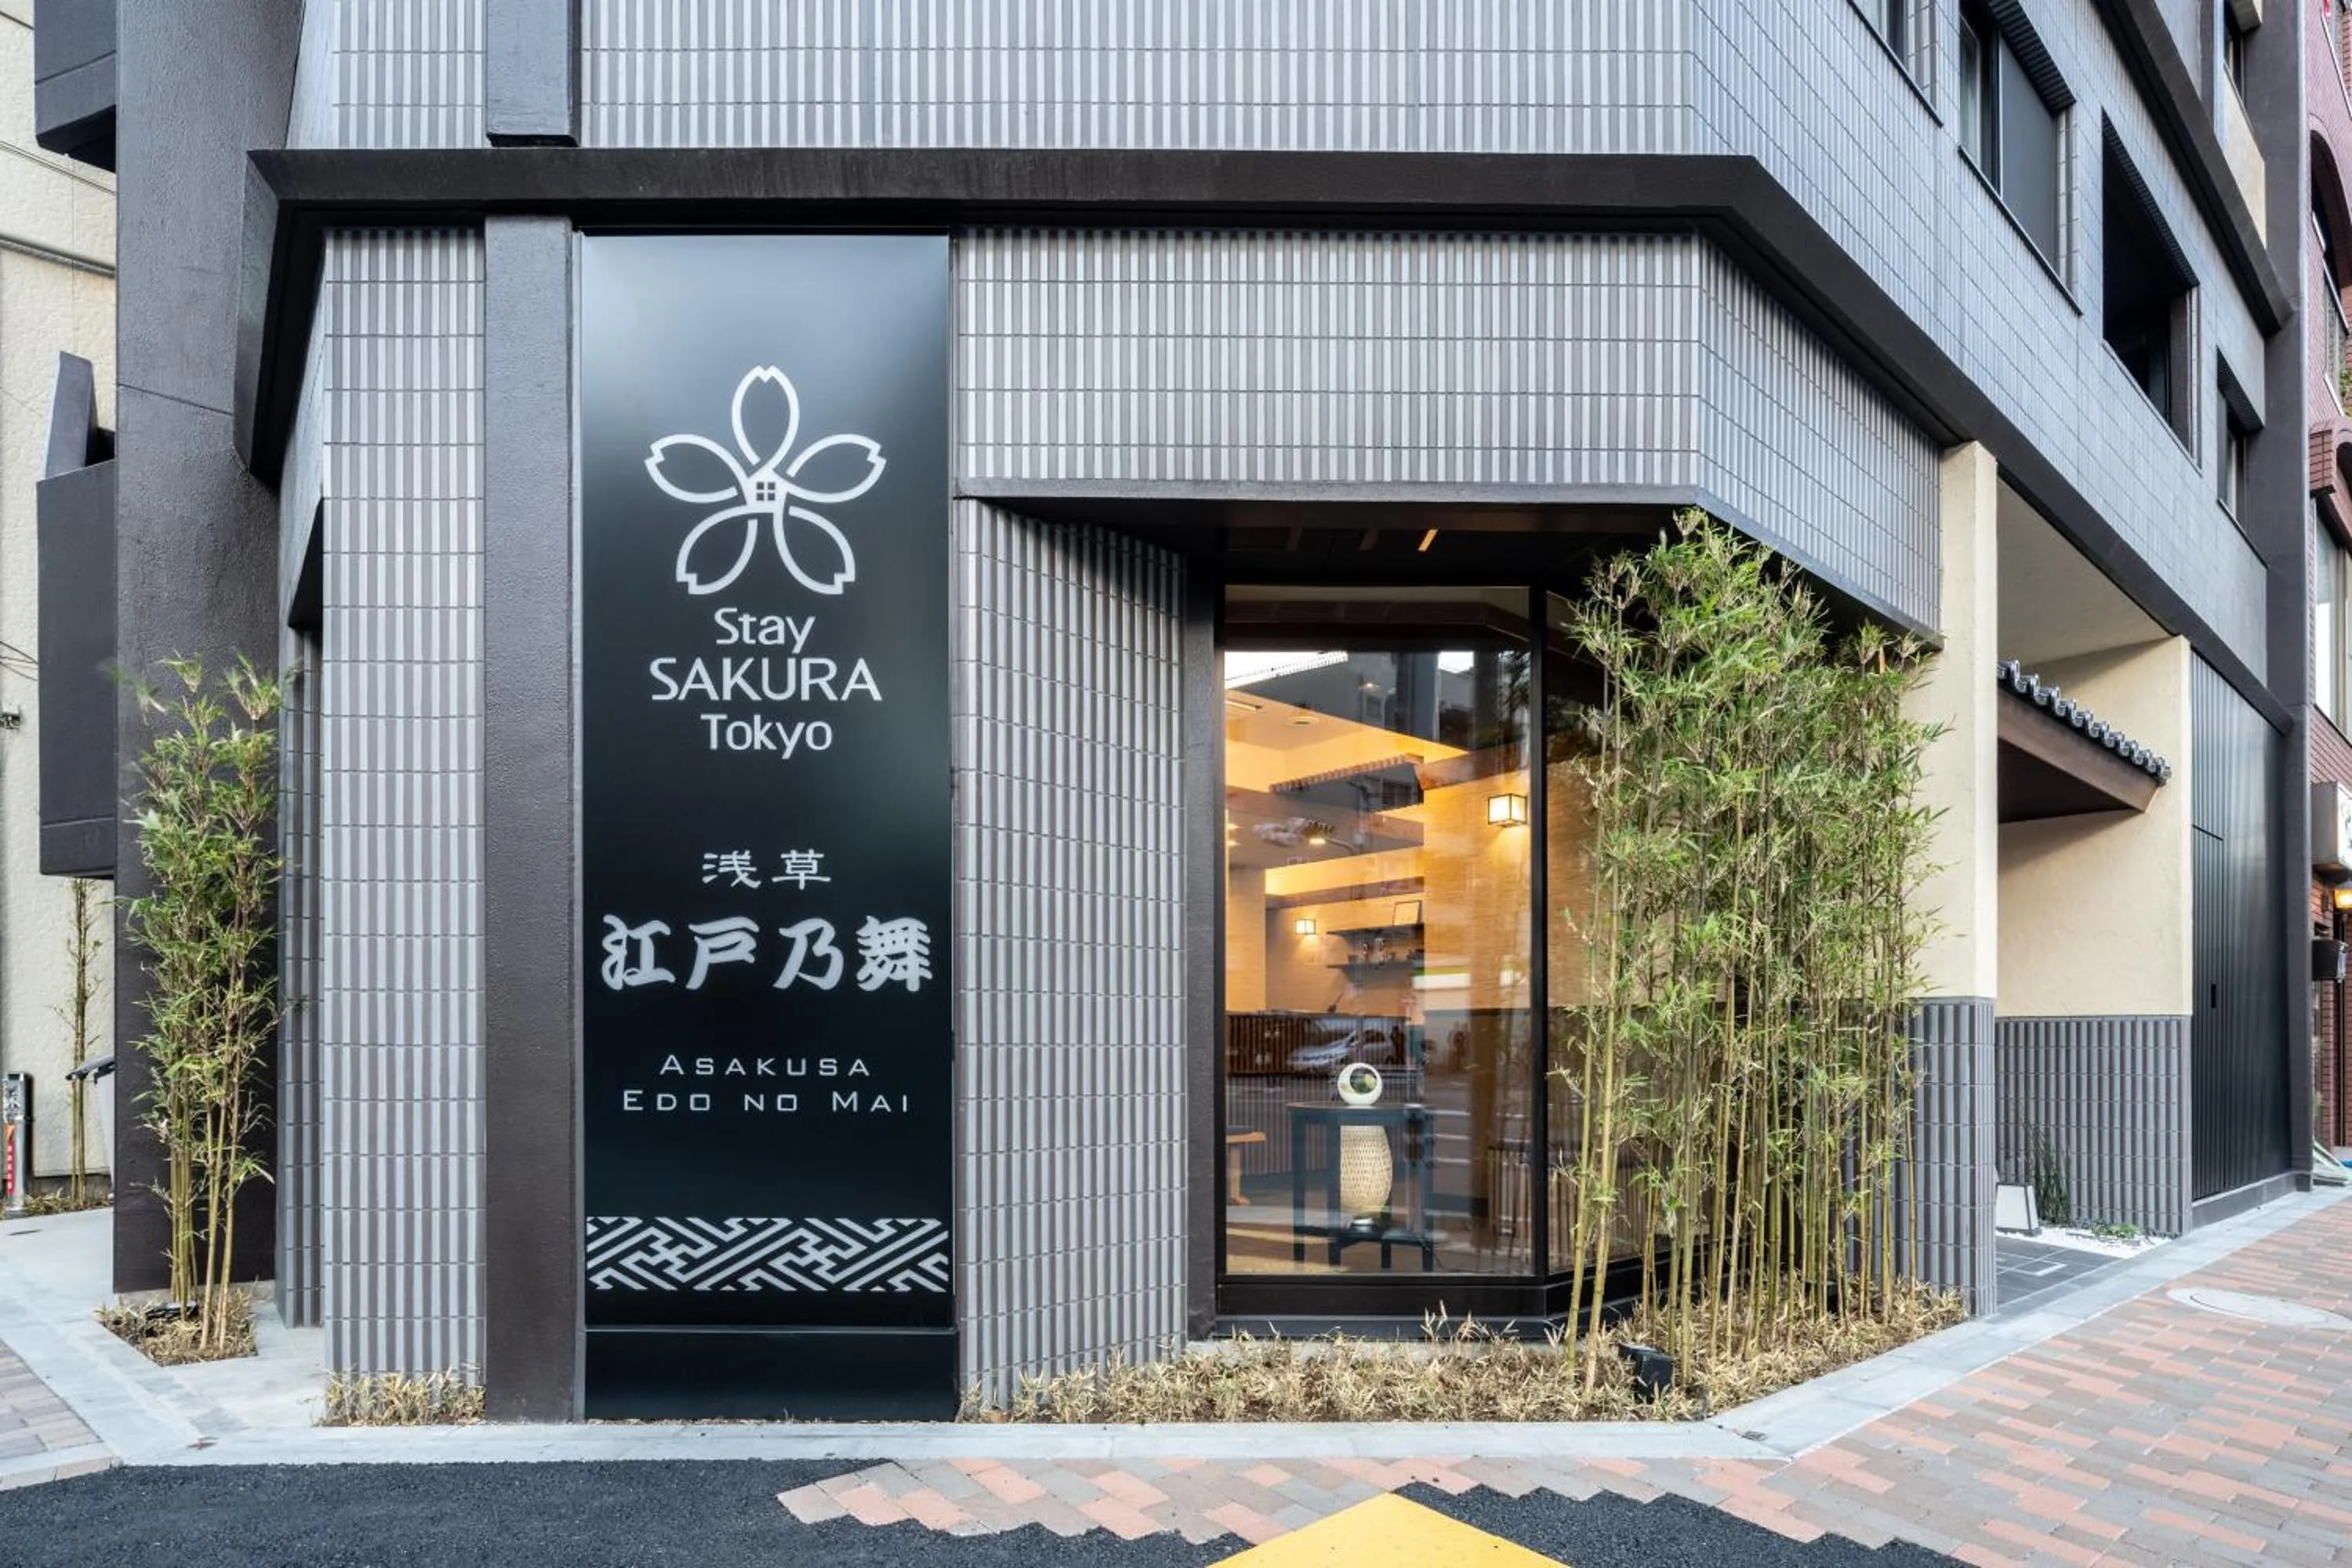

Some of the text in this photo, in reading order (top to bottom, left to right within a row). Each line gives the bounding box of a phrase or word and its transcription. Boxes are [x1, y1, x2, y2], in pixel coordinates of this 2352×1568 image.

[715, 608, 815, 653] Stay
[651, 658, 882, 701] SAKURA
[701, 714, 832, 759] Tokyo
[702, 849, 831, 889] 浅草
[602, 915, 933, 991] 江戸乃舞
[660, 1054, 869, 1076] ASAKUSA
[623, 1090, 908, 1112] EDO NO MAI
